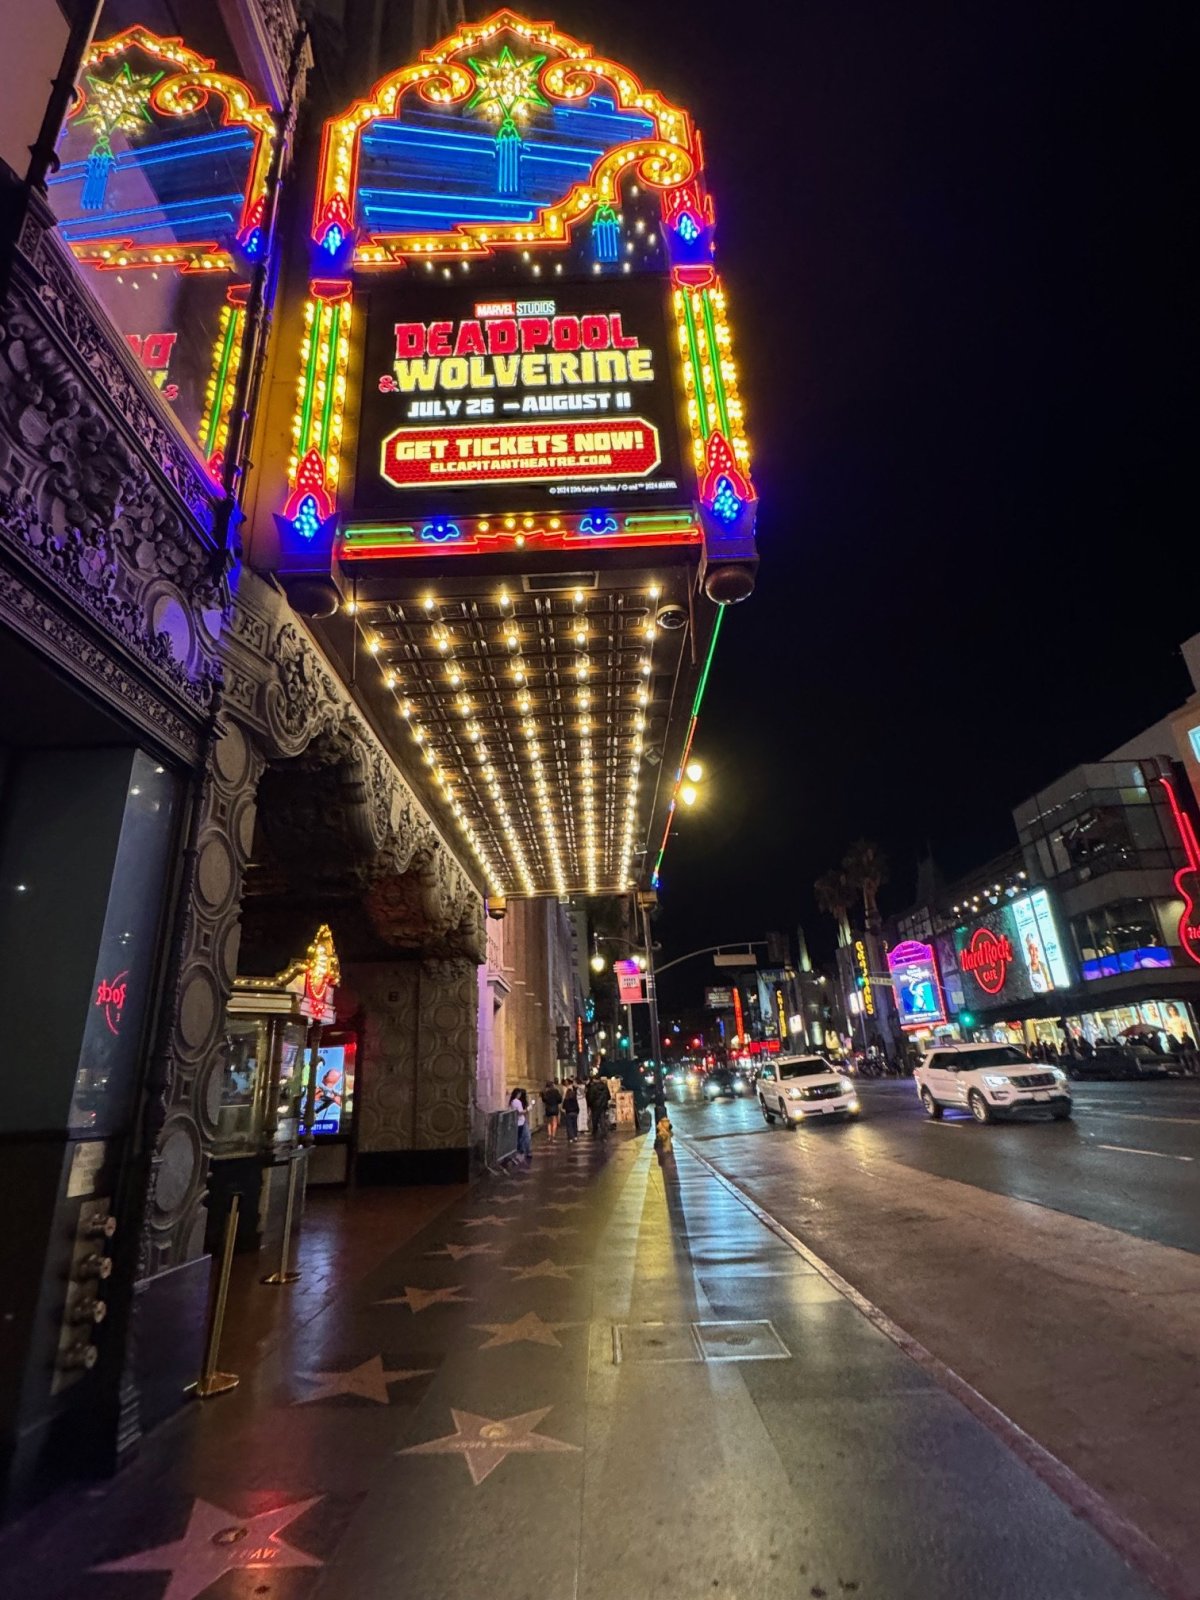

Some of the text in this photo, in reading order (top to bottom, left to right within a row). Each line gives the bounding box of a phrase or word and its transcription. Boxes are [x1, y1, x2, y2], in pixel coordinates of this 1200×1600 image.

[477, 301, 556, 317] MARVEL STUDIOS
[394, 313, 639, 359] DEADPOOL
[378, 349, 655, 393] & WOLVERINE
[407, 399, 462, 418] JULY
[466, 398, 495, 415] 26
[395, 430, 644, 460] GET TICKETS NOW!
[429, 454, 612, 474] ELCAPITANTHEATRE.COM
[961, 942, 983, 971] Hard
[982, 934, 1012, 967] Rock
